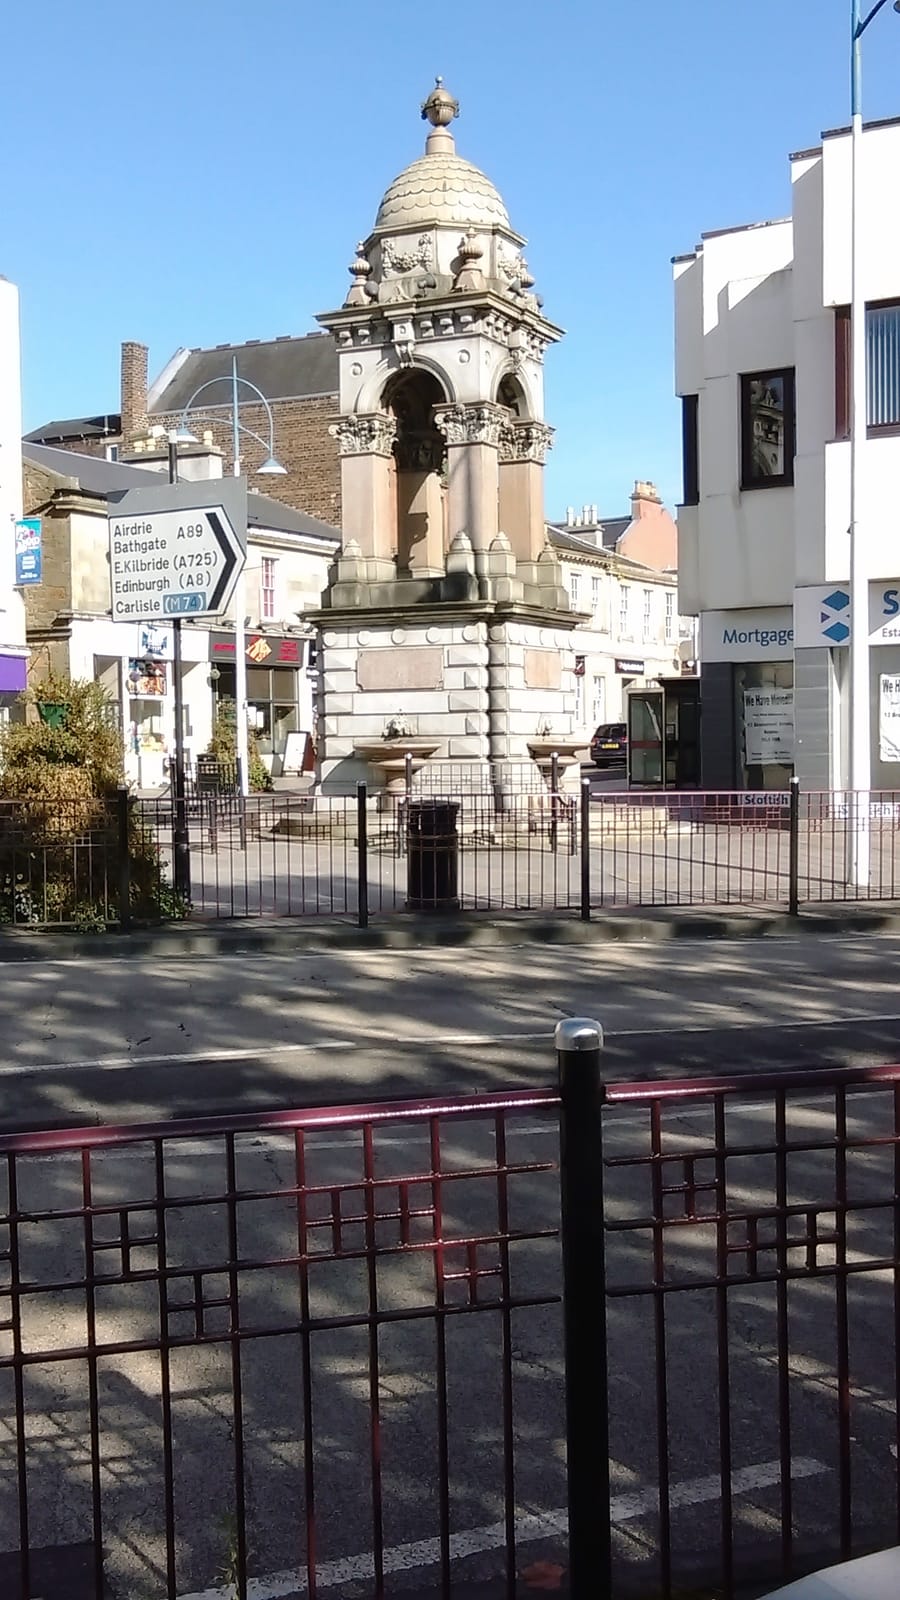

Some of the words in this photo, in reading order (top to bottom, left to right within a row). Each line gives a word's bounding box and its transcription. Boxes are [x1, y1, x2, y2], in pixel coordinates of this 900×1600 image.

[114, 522, 152, 537] Airdrie
[177, 524, 203, 539] A89
[114, 538, 167, 554] Bathgate
[115, 558, 170, 574] E.Kilbride
[173, 550, 218, 571] (A725)
[115, 576, 170, 593] Edinburgh
[179, 571, 211, 589] (A8)
[116, 599, 160, 614] Carlisle
[744, 794, 788, 805] Scottish
